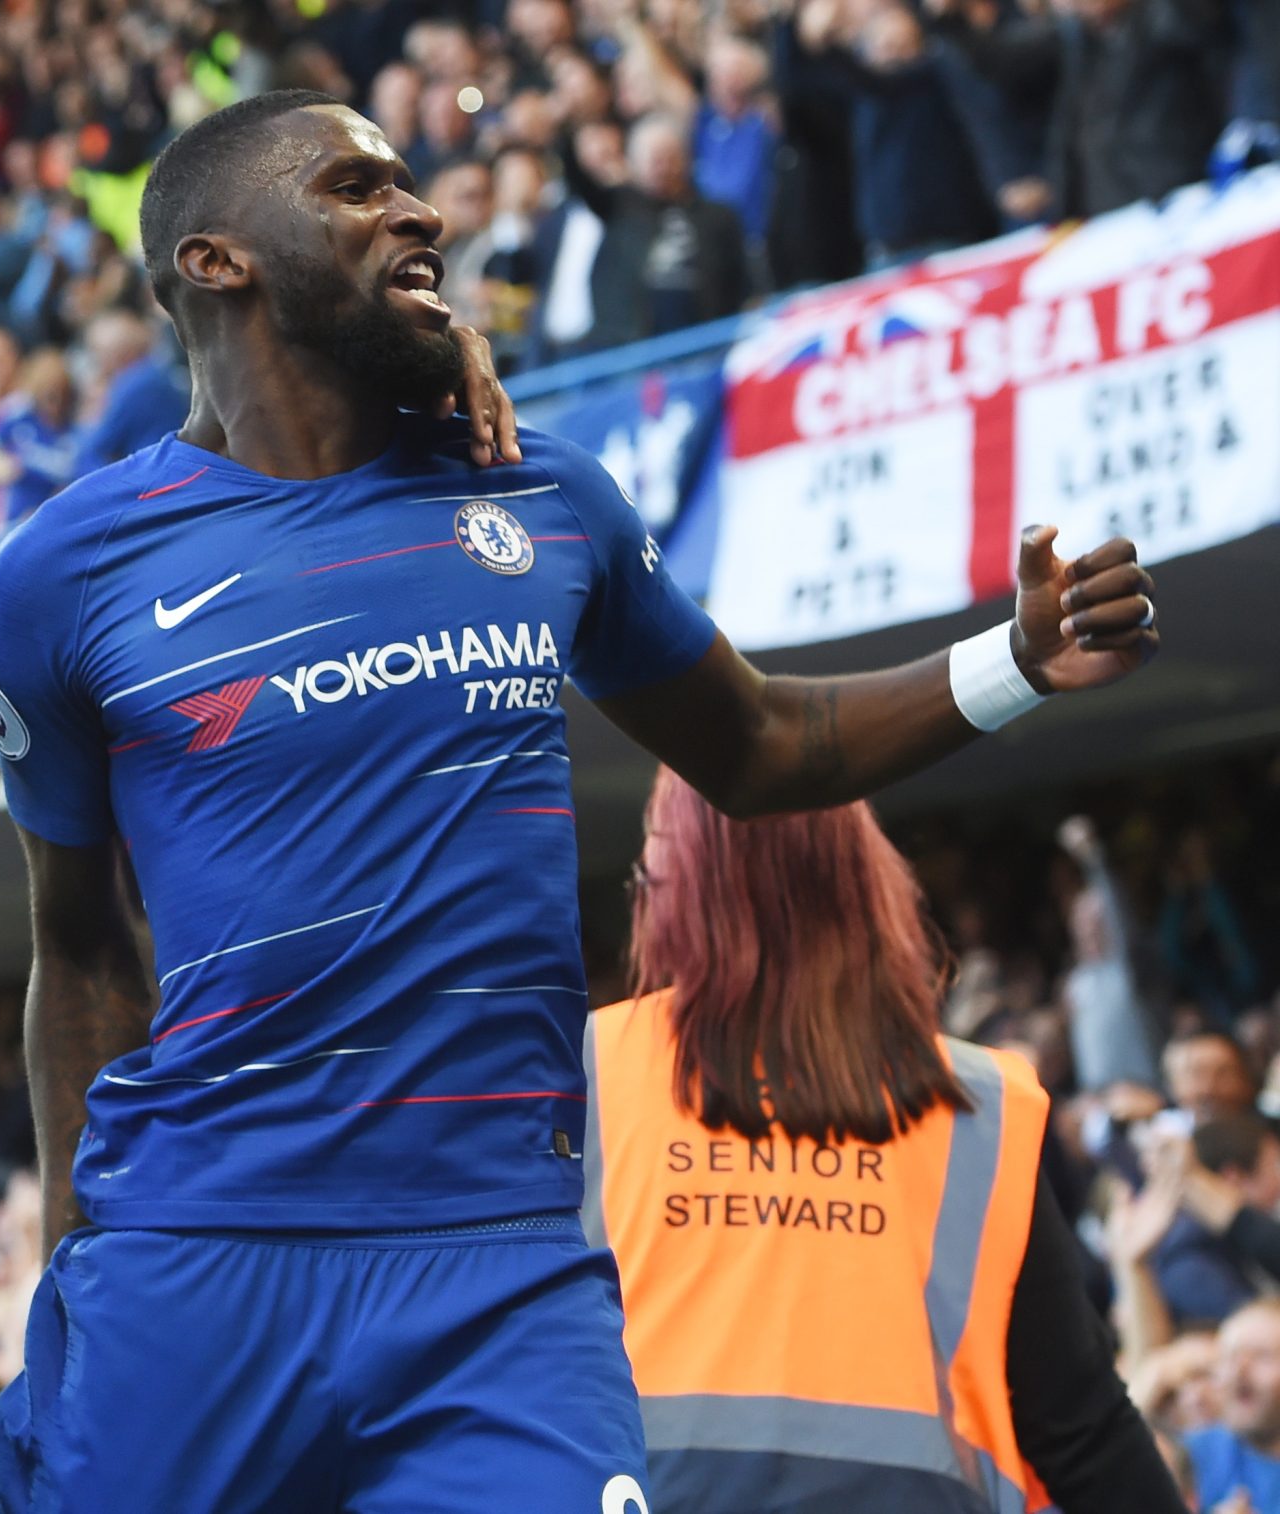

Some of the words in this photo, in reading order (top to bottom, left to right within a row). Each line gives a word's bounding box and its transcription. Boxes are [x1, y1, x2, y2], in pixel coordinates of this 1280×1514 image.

[793, 292, 1101, 440] CHELSEA
[1115, 257, 1214, 356] FC
[461, 504, 507, 520] CHELSEA
[270, 622, 560, 714] YOKOHAMA
[463, 676, 558, 714] TYRES
[668, 1141, 883, 1182] SENIOR
[665, 1194, 886, 1235] STEWARD
